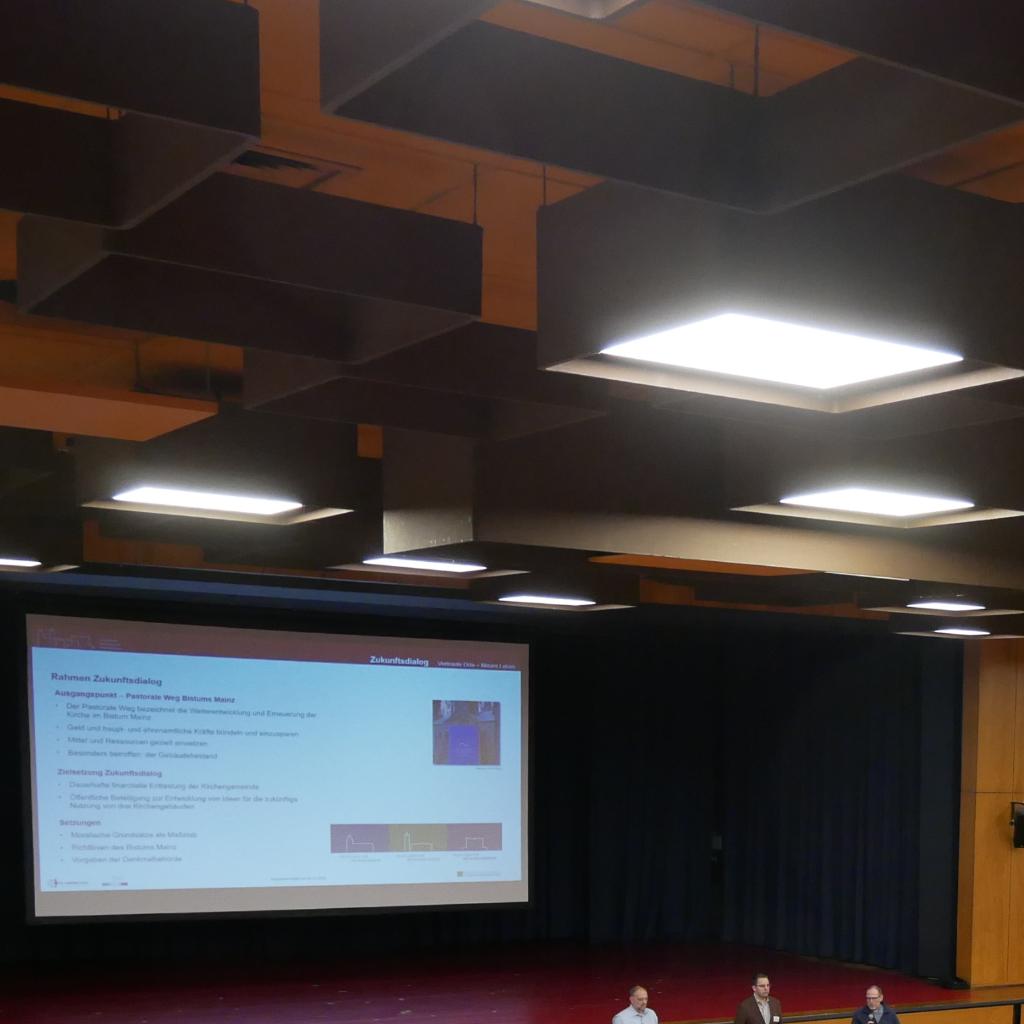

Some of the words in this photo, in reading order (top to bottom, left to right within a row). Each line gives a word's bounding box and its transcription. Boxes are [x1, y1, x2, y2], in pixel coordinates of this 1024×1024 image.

[369, 656, 429, 667] Zukunftsdialog
[51, 672, 91, 682] Rahmen
[92, 674, 162, 687] Zukunftsdialog
[54, 689, 117, 699] Ausgangspunkt
[125, 693, 162, 701] Pastorale
[163, 694, 180, 702] Weg
[214, 696, 235, 704] Mainz
[105, 769, 162, 779] Zukunftsdialog
